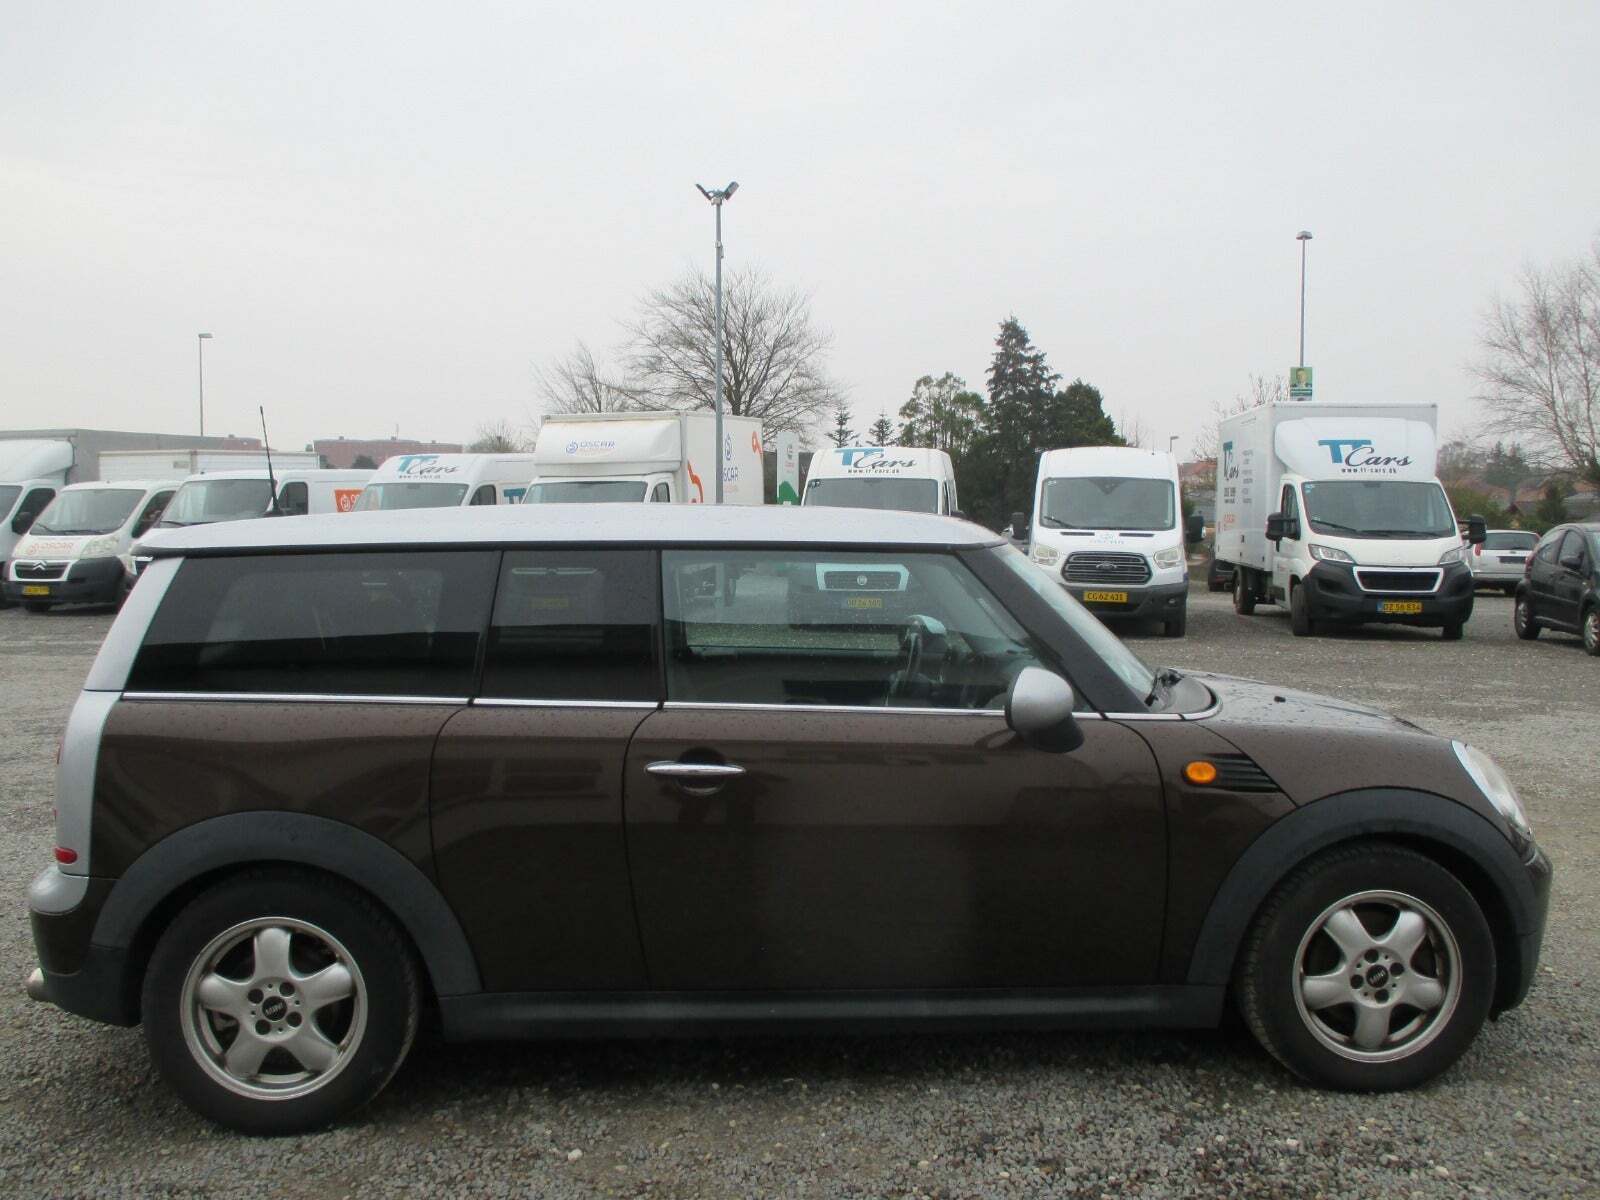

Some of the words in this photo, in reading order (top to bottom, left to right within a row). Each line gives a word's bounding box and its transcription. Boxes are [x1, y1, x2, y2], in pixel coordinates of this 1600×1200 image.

[853, 452, 918, 469] Cars
[1344, 446, 1414, 467] Cars
[406, 460, 458, 475] Cars
